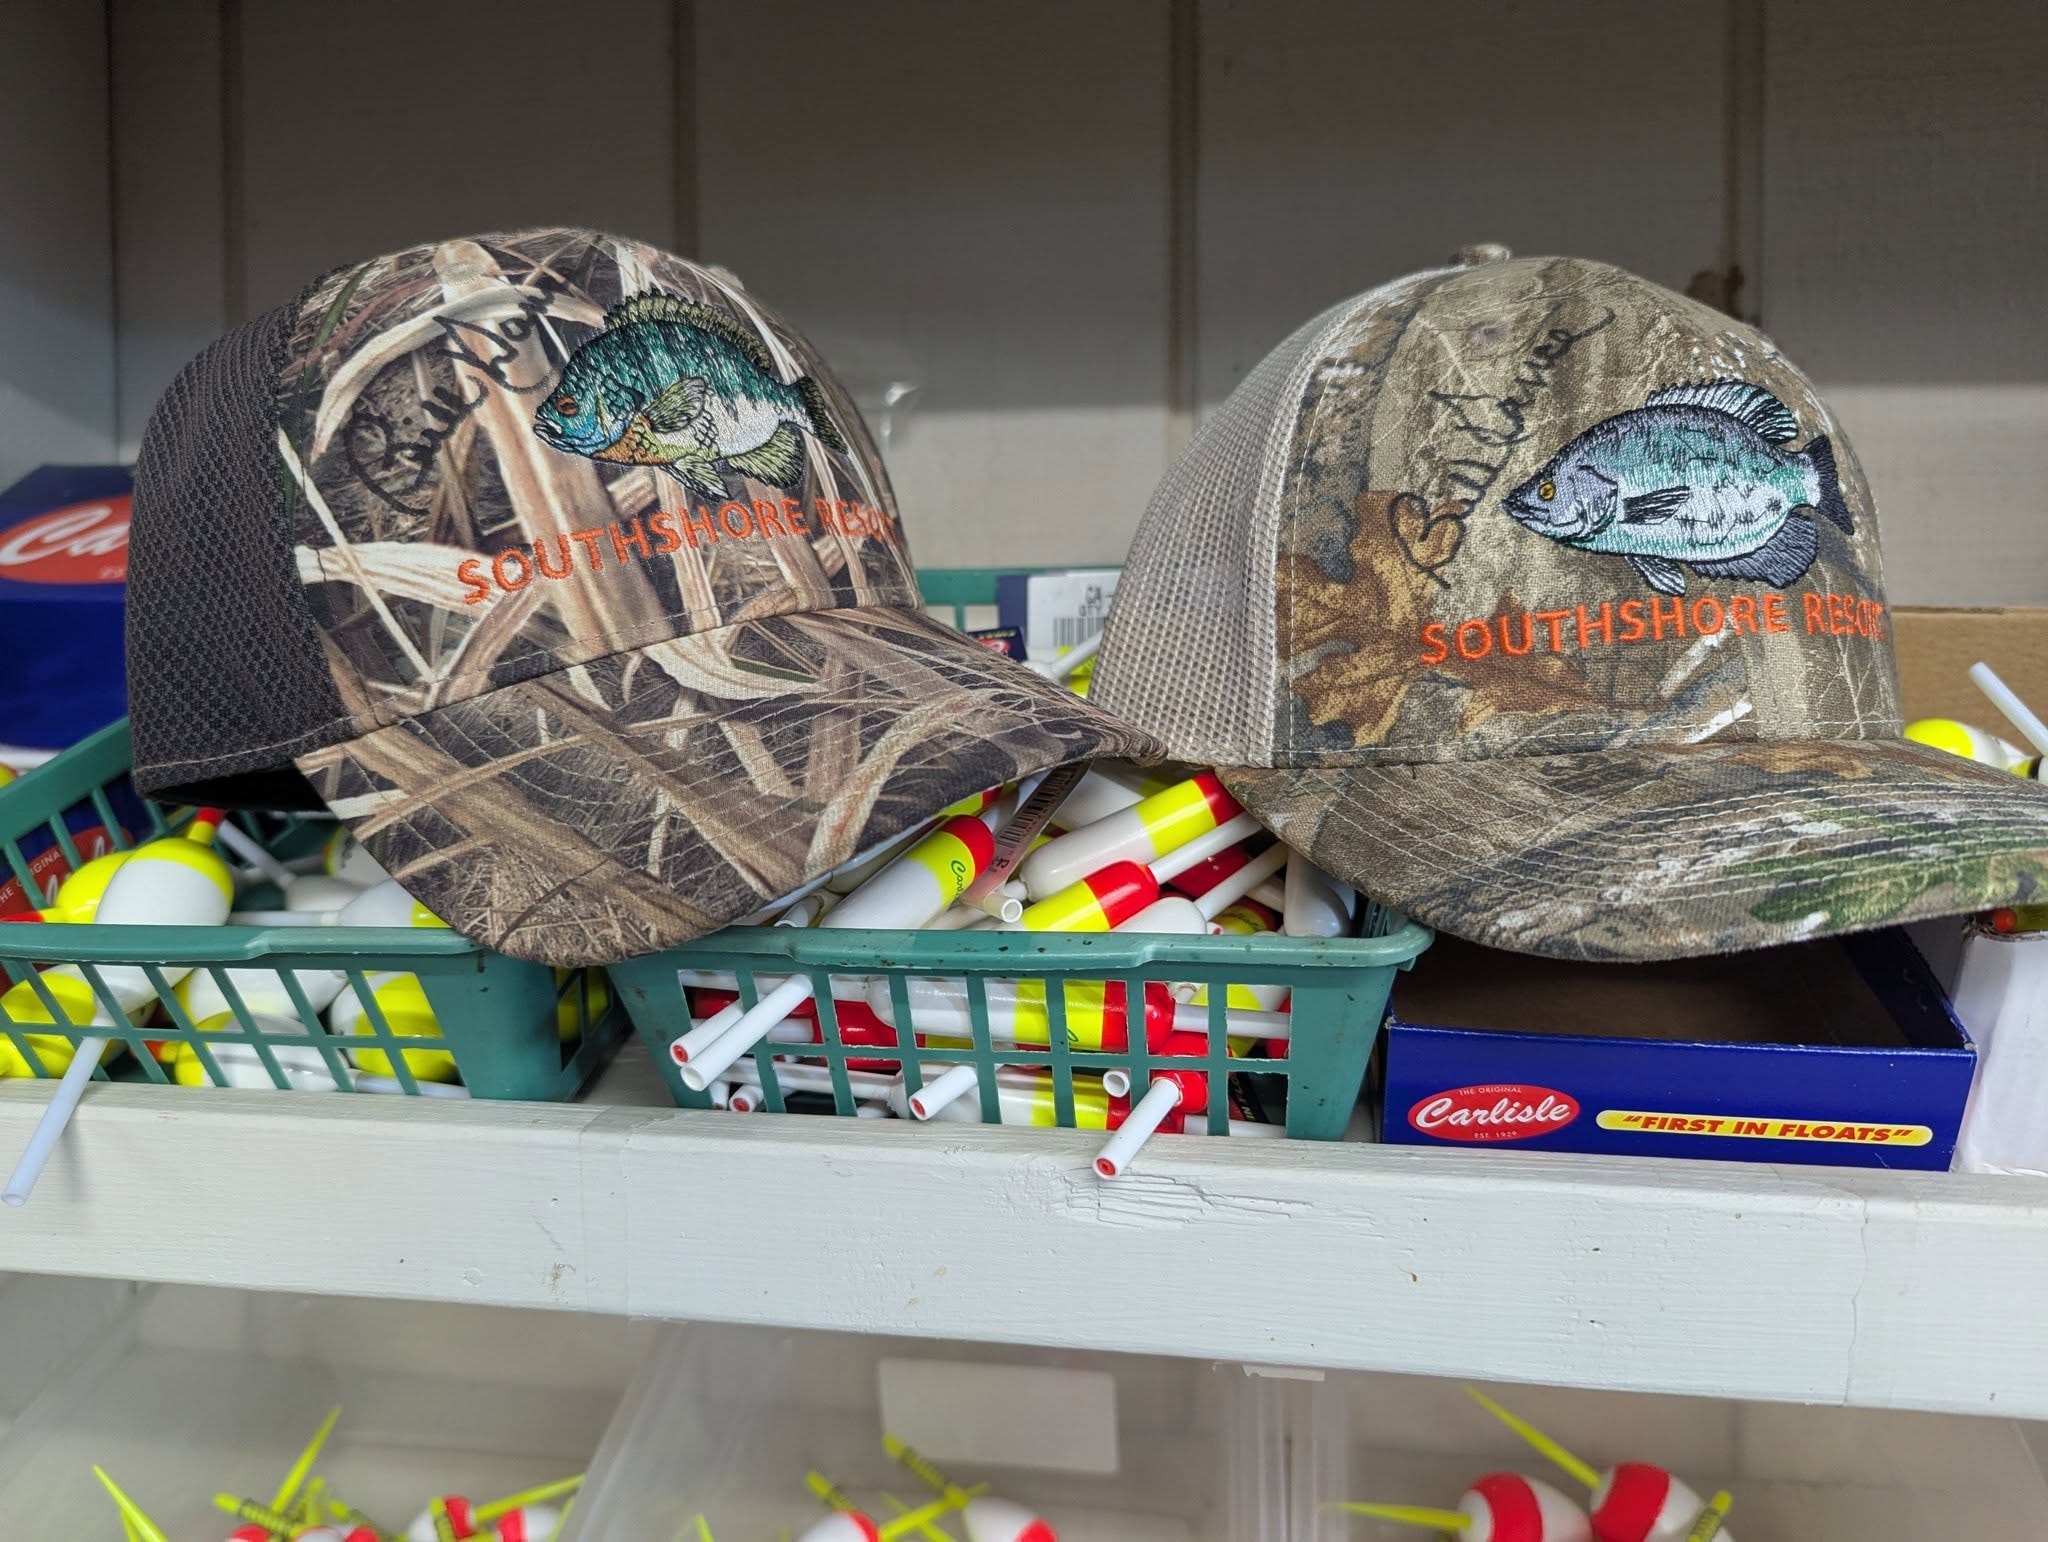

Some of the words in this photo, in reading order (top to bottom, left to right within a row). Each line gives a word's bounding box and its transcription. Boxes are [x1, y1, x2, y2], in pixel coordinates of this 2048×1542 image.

[456, 499, 811, 605] SOUTHSHORE
[1419, 593, 1789, 665] SOUTHSHORE
[1458, 1088, 1475, 1097] THE
[1478, 1086, 1522, 1095] ORIGINAL
[1415, 1095, 1570, 1129] Carlisle
[1731, 1120, 1771, 1137] IN
